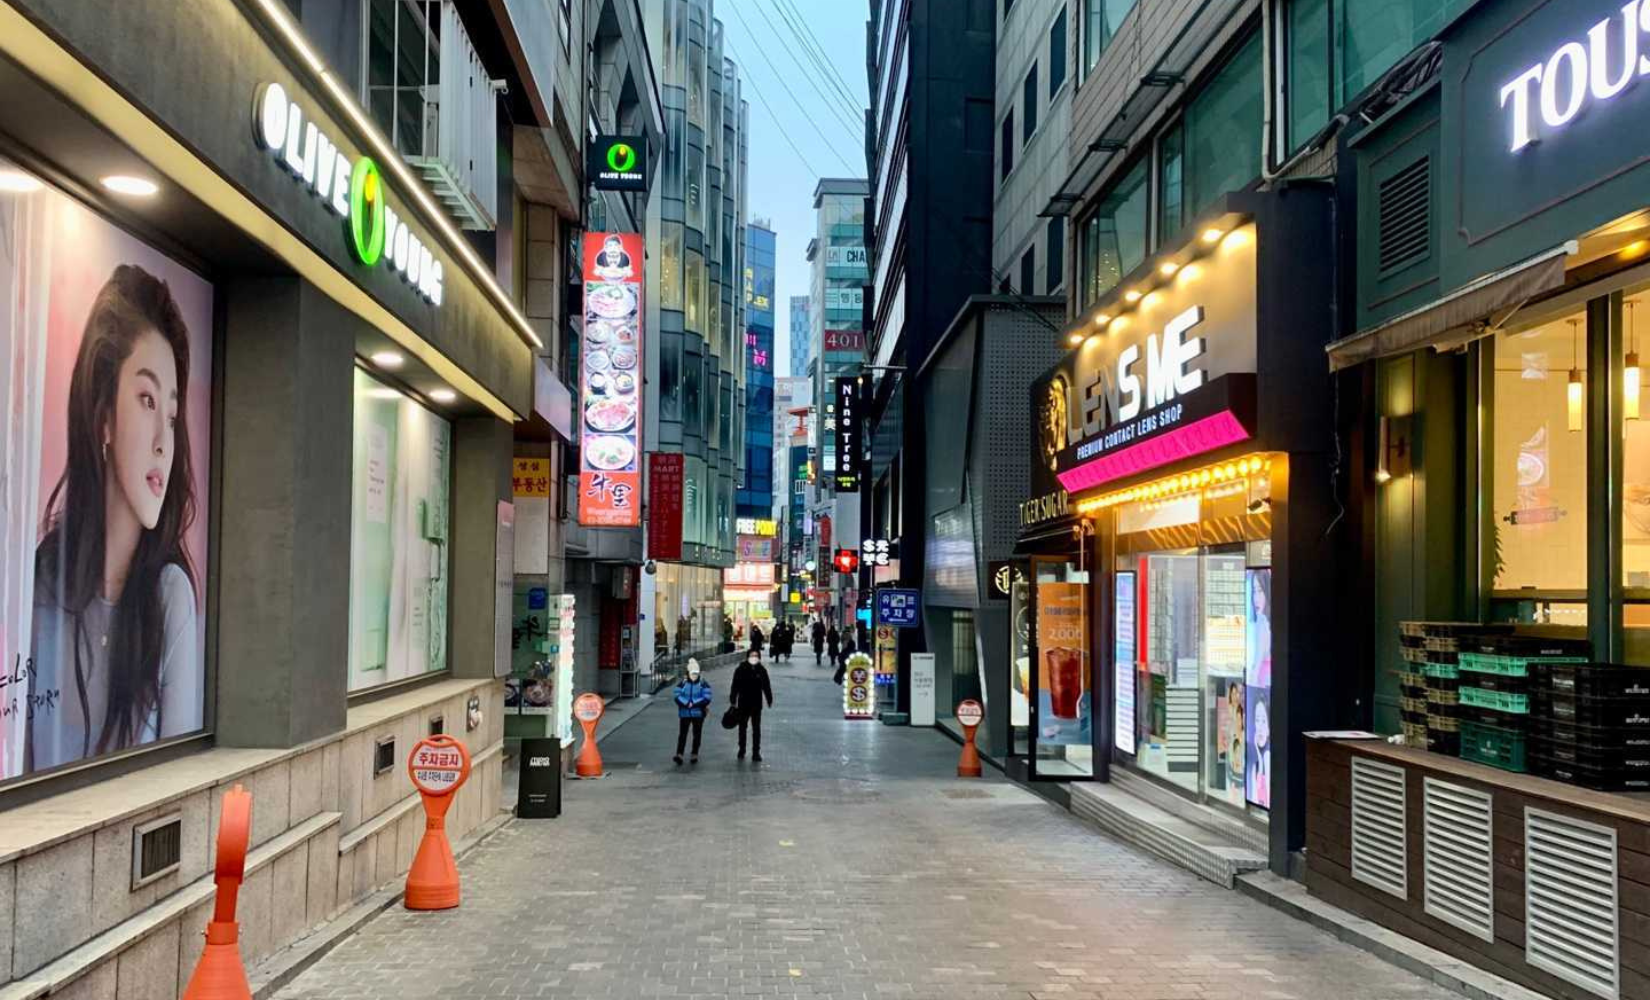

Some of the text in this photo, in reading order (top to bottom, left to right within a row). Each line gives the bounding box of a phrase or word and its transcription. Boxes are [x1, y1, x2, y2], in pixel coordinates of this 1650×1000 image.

[258, 82, 442, 306] OLIVE YOUNG
[1066, 304, 1207, 446] LENS ME
[841, 384, 853, 427] Nine
[841, 432, 853, 472] Tree
[1076, 403, 1183, 460] PREMIUM CONTACT LENS SHOP
[512, 476, 548, 494] 부동산
[1019, 489, 1069, 527] TIGER SUGAR
[418, 752, 459, 766] 주차금지
